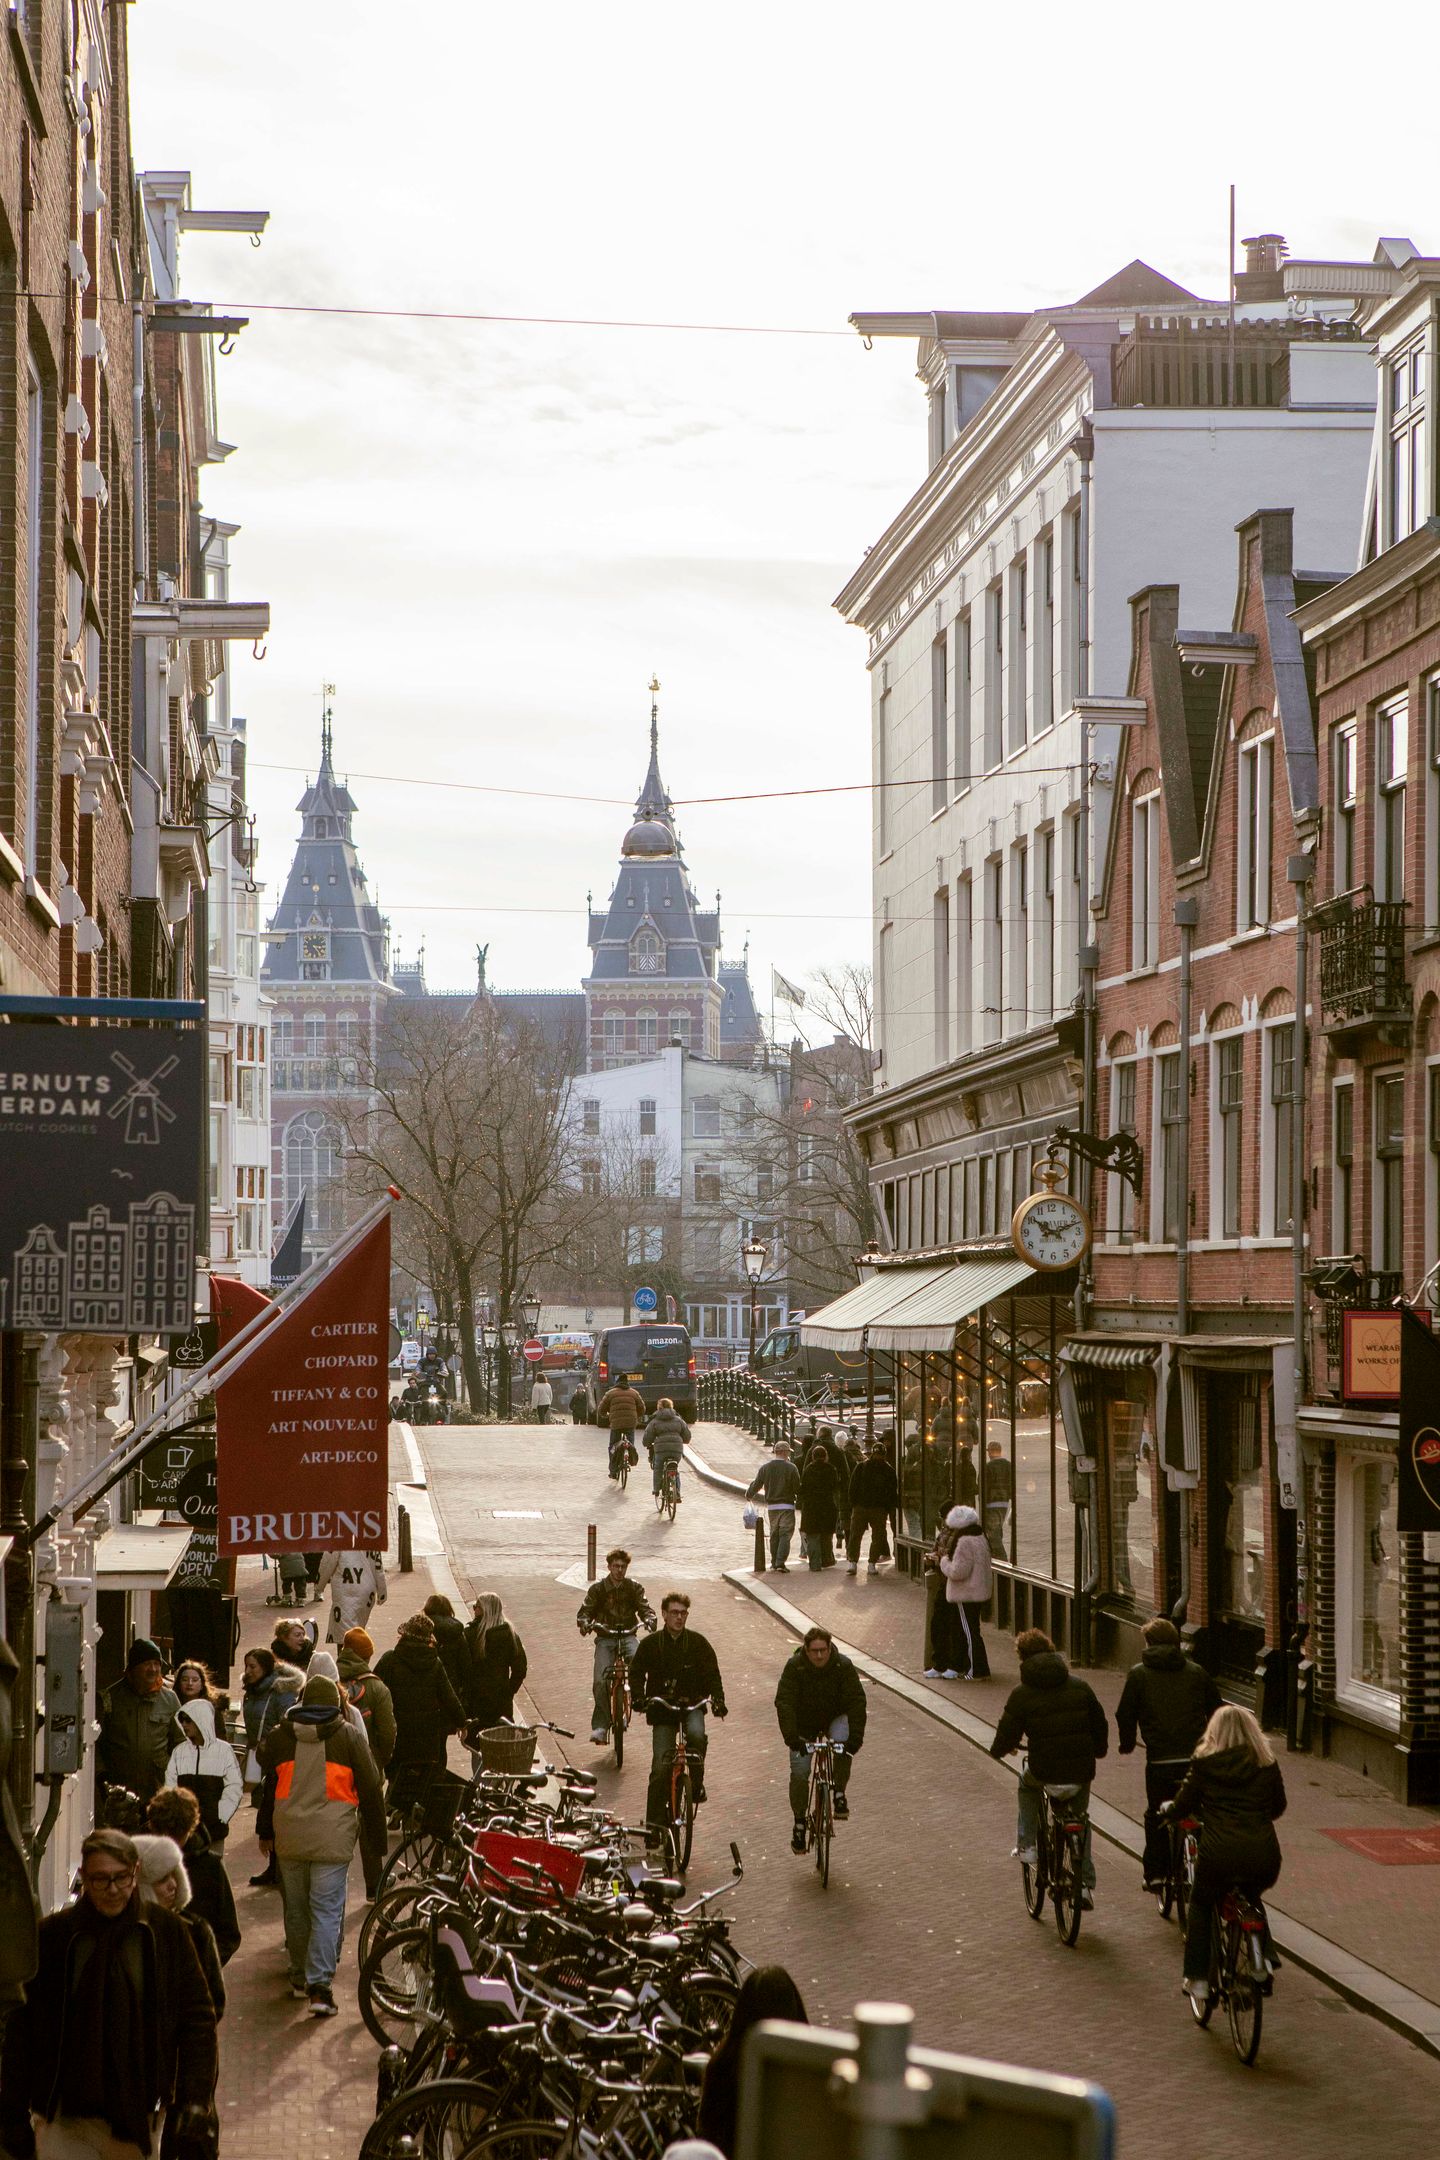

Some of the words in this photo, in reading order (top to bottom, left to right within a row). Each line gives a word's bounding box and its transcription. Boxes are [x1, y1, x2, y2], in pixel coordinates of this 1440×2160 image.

[1037, 1206, 1043, 1215] 11
[1047, 1203, 1056, 1212] 12
[1062, 1205, 1066, 1214] 1
[1027, 1216, 1036, 1225] 10
[1071, 1214, 1077, 1223] 2
[1023, 1228, 1029, 1237] 9
[1075, 1227, 1081, 1236] 3
[1027, 1241, 1034, 1249] 8
[1071, 1239, 1076, 1248] 4
[1039, 1249, 1045, 1258] 7
[1050, 1252, 1056, 1260] 6
[1063, 1249, 1069, 1258] 5
[311, 1322, 378, 1338] CARTIER
[304, 1354, 378, 1370] CHOPARD
[272, 1387, 336, 1402] TIFFANY
[339, 1386, 351, 1400] &
[355, 1386, 378, 1400] CO
[267, 1420, 300, 1434] ART
[302, 1418, 379, 1433] NOUVEAU
[300, 1450, 378, 1465] ART-DECO
[155, 1495, 167, 1503] Art
[227, 1510, 382, 1545] BRUENS
[178, 1562, 213, 1577] OPEN
